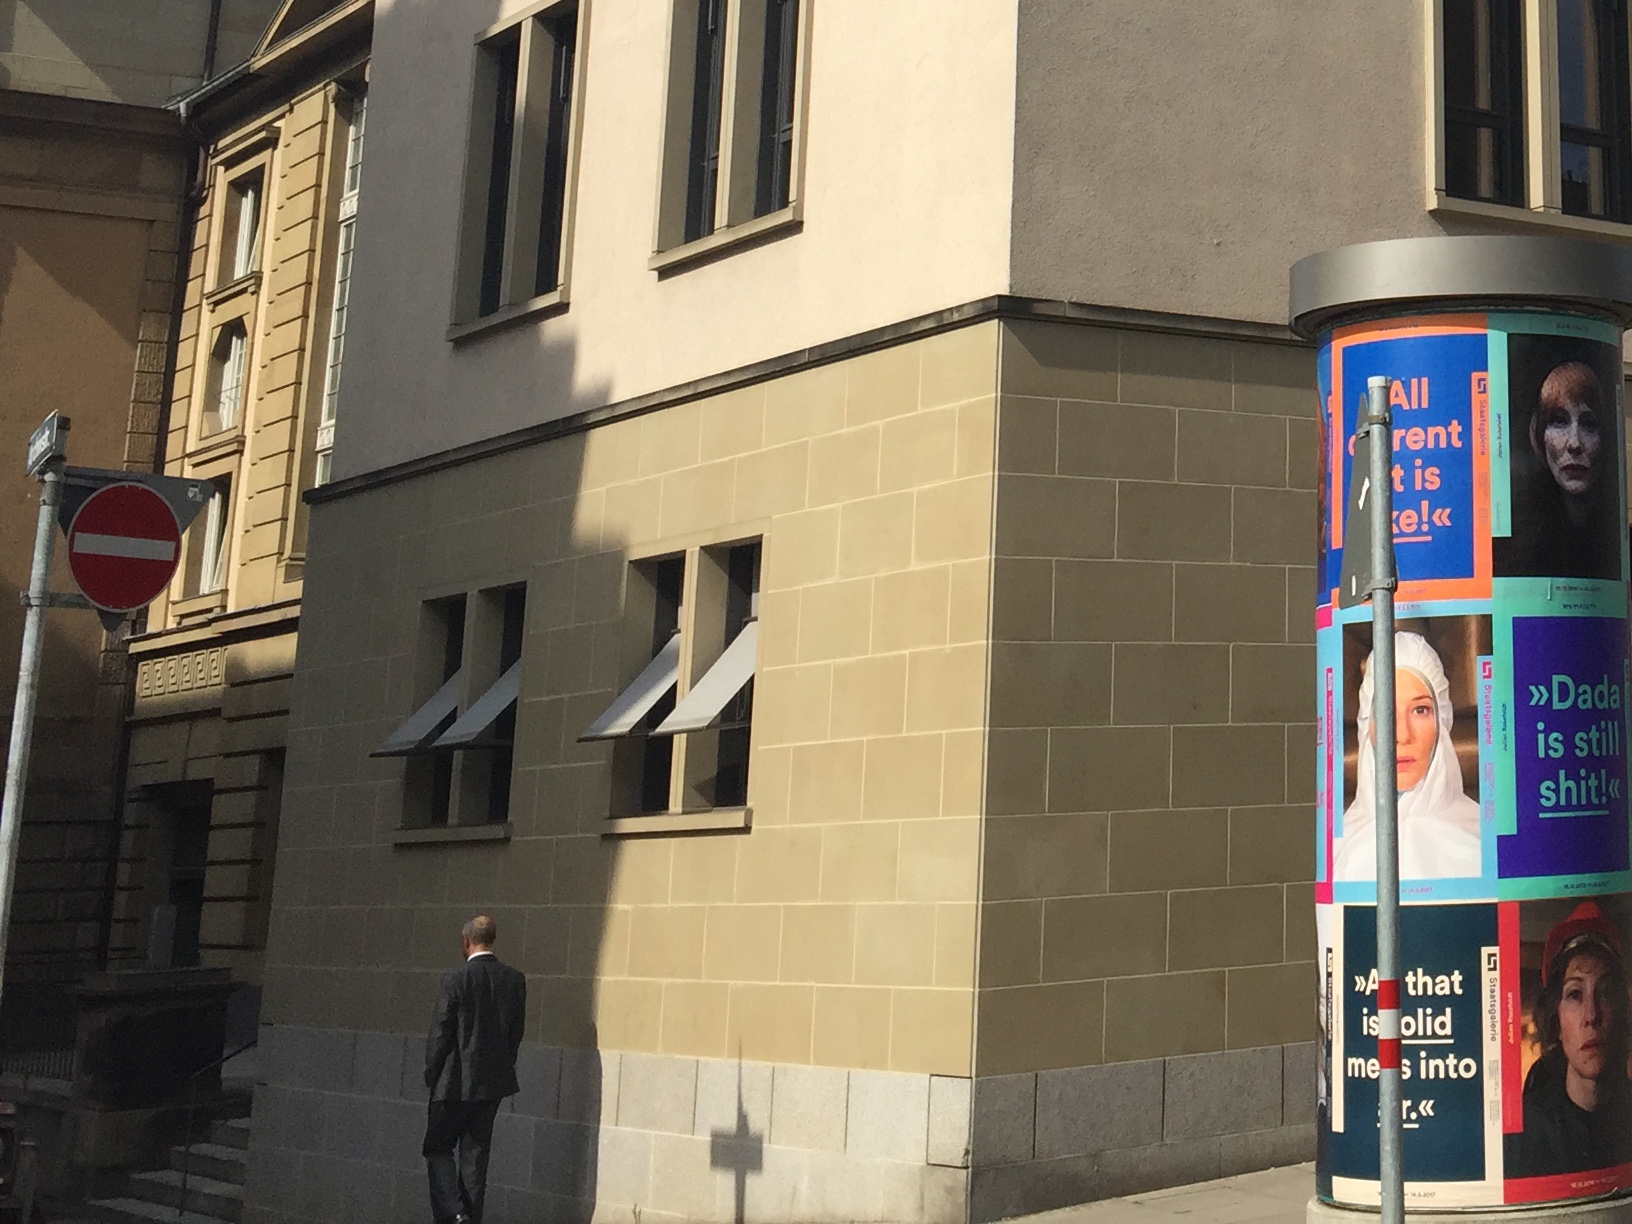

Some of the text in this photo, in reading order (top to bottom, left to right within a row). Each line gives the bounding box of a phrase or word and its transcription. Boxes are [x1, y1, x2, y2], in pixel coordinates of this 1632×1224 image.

[1413, 458, 1441, 491] is
[1528, 673, 1621, 711] »Dada
[1536, 720, 1620, 759] is still
[1539, 768, 1621, 808] shit!«
[1354, 967, 1464, 996] »A that
[1362, 1007, 1380, 1036] is
[1400, 1007, 1453, 1036] olid
[1346, 1050, 1478, 1080] mes into
